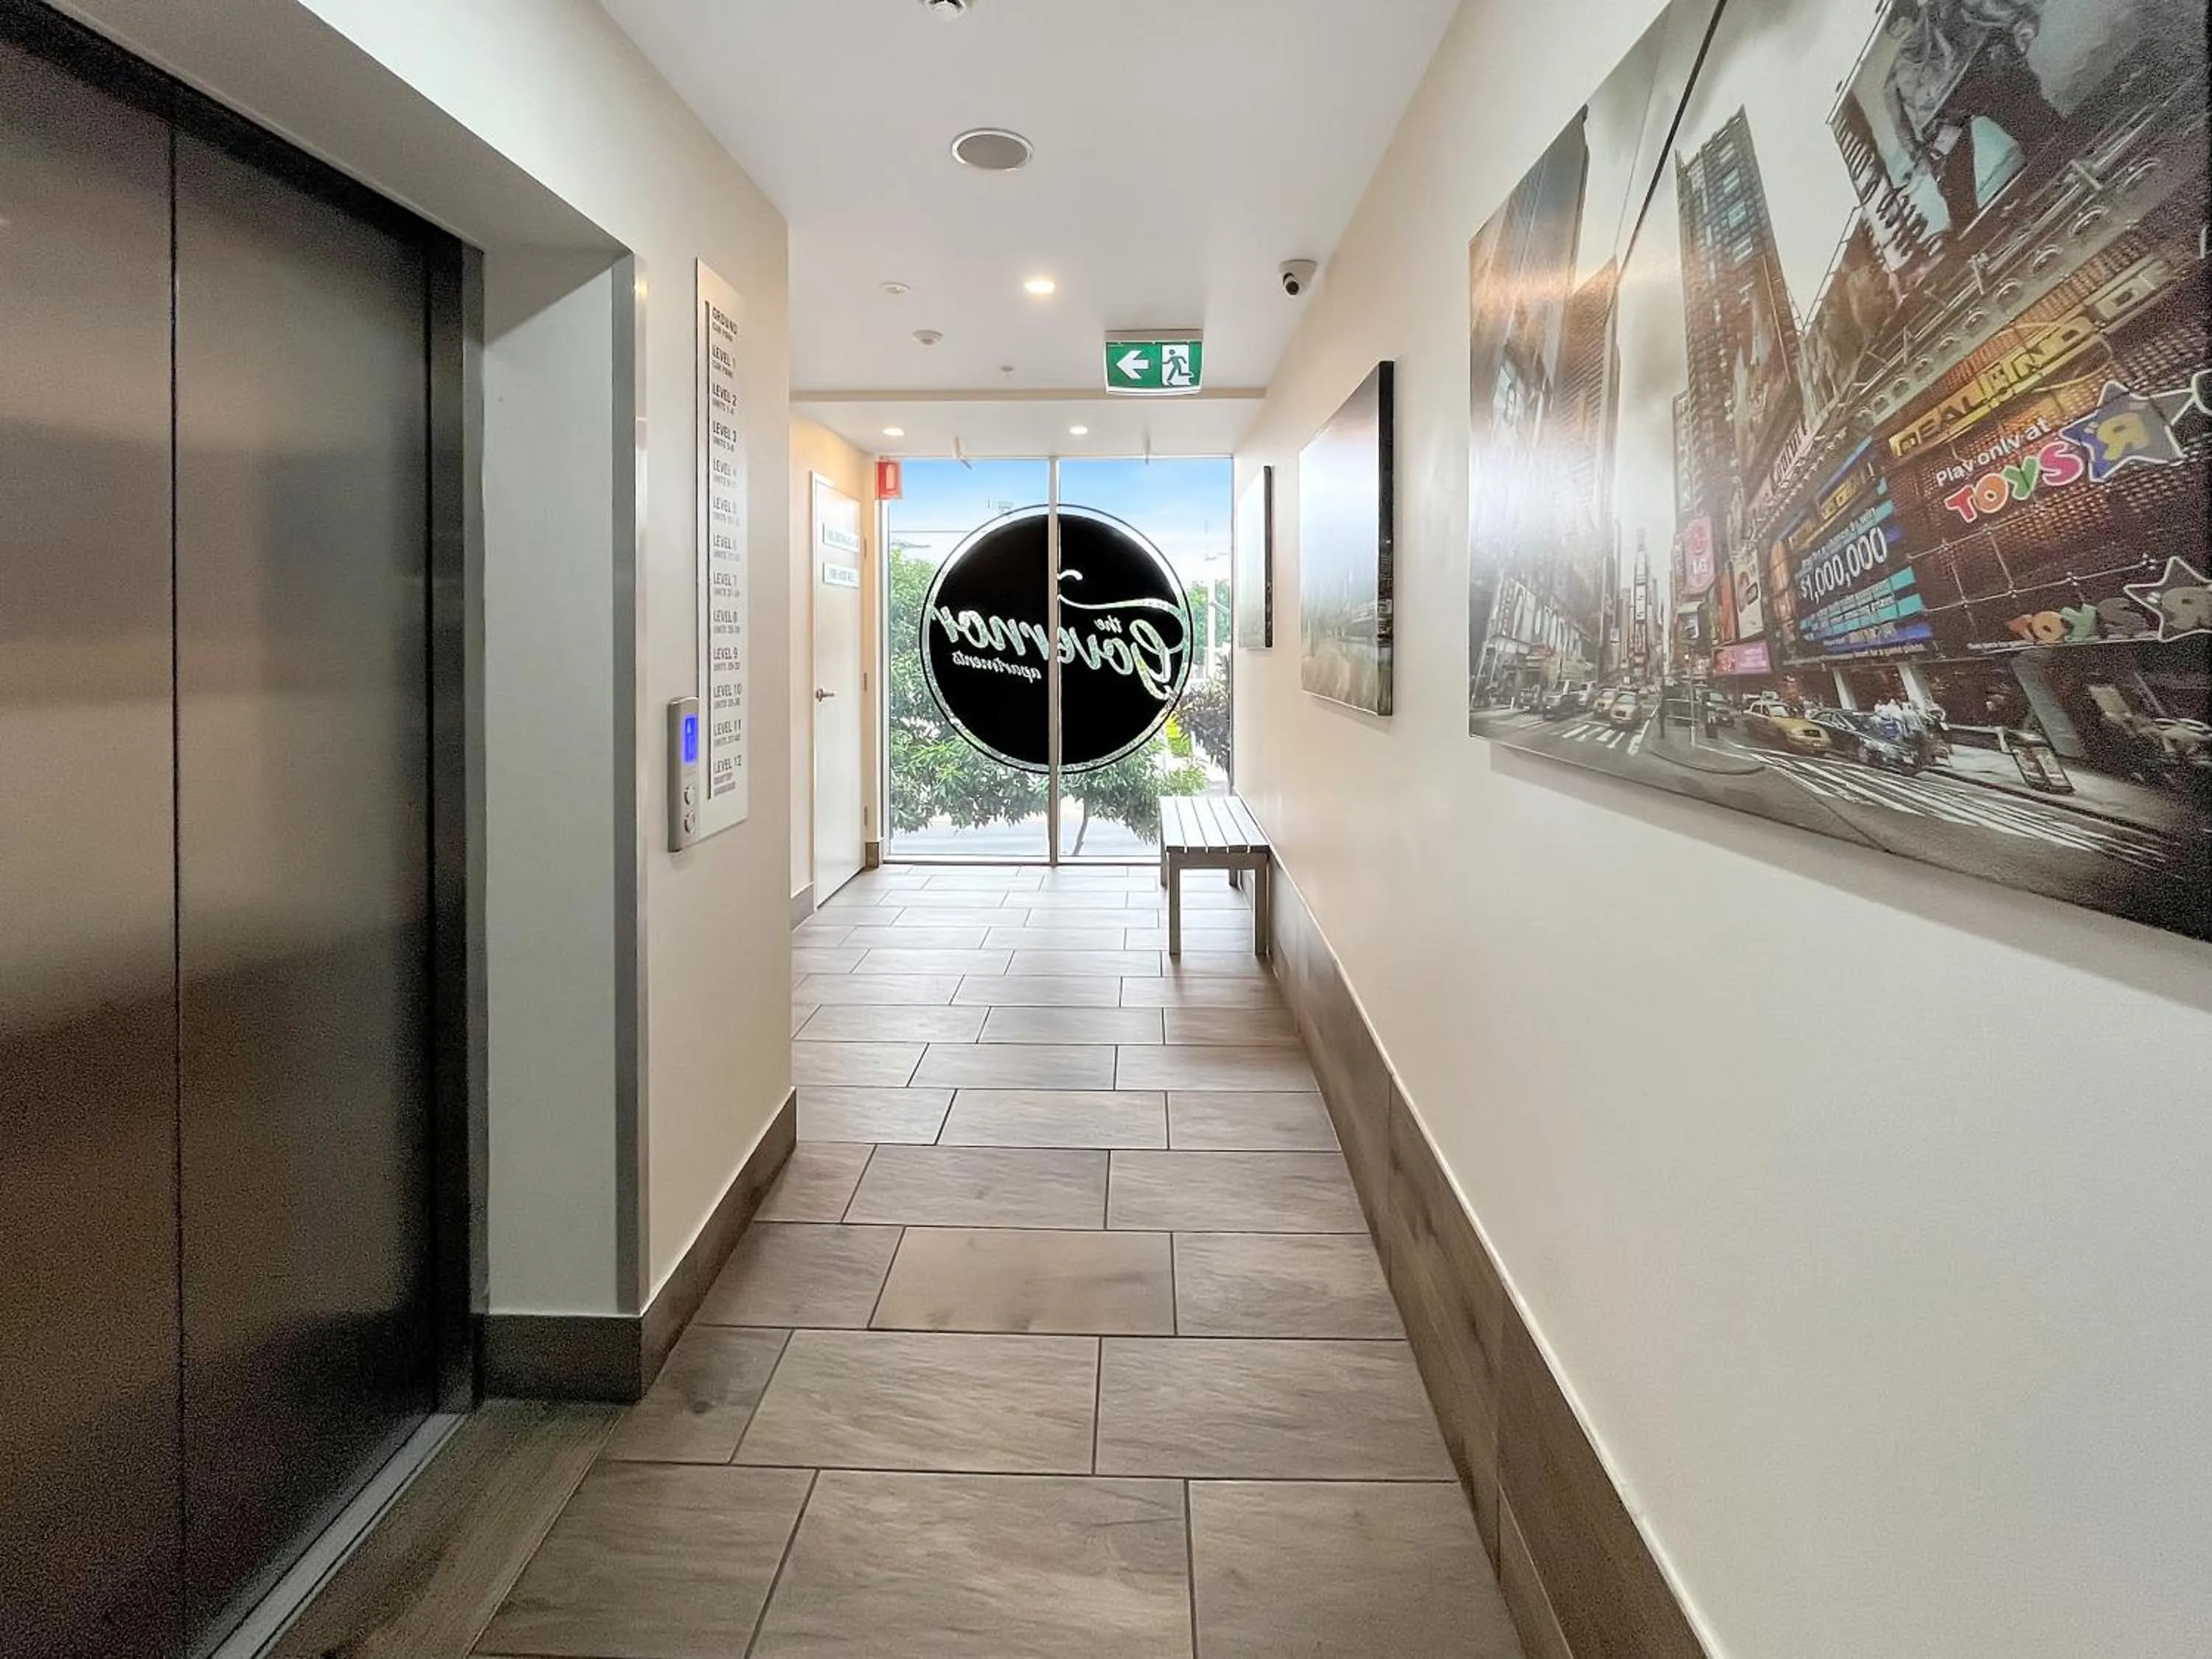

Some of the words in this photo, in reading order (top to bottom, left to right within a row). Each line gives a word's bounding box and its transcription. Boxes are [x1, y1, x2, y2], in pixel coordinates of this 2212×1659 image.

[712, 345, 731, 367] LEVEL
[712, 383, 731, 404] LEVEL
[732, 394, 737, 407] 2
[713, 420, 731, 440] LEVEL
[1935, 456, 1976, 487] Play
[2026, 417, 2052, 441] at
[713, 458, 731, 476] LEVEL
[1945, 442, 2084, 523] TOYS
[713, 495, 731, 512] LEVEL
[713, 533, 732, 549] LEVEL
[1800, 526, 1888, 605] $1,000,000
[713, 572, 732, 586] LEVEL
[713, 610, 732, 623] LEVEL
[713, 647, 732, 660] LEVEL
[713, 685, 732, 698] LEVEL
[713, 720, 732, 737] LEVEL
[713, 757, 732, 773] LEVEL
